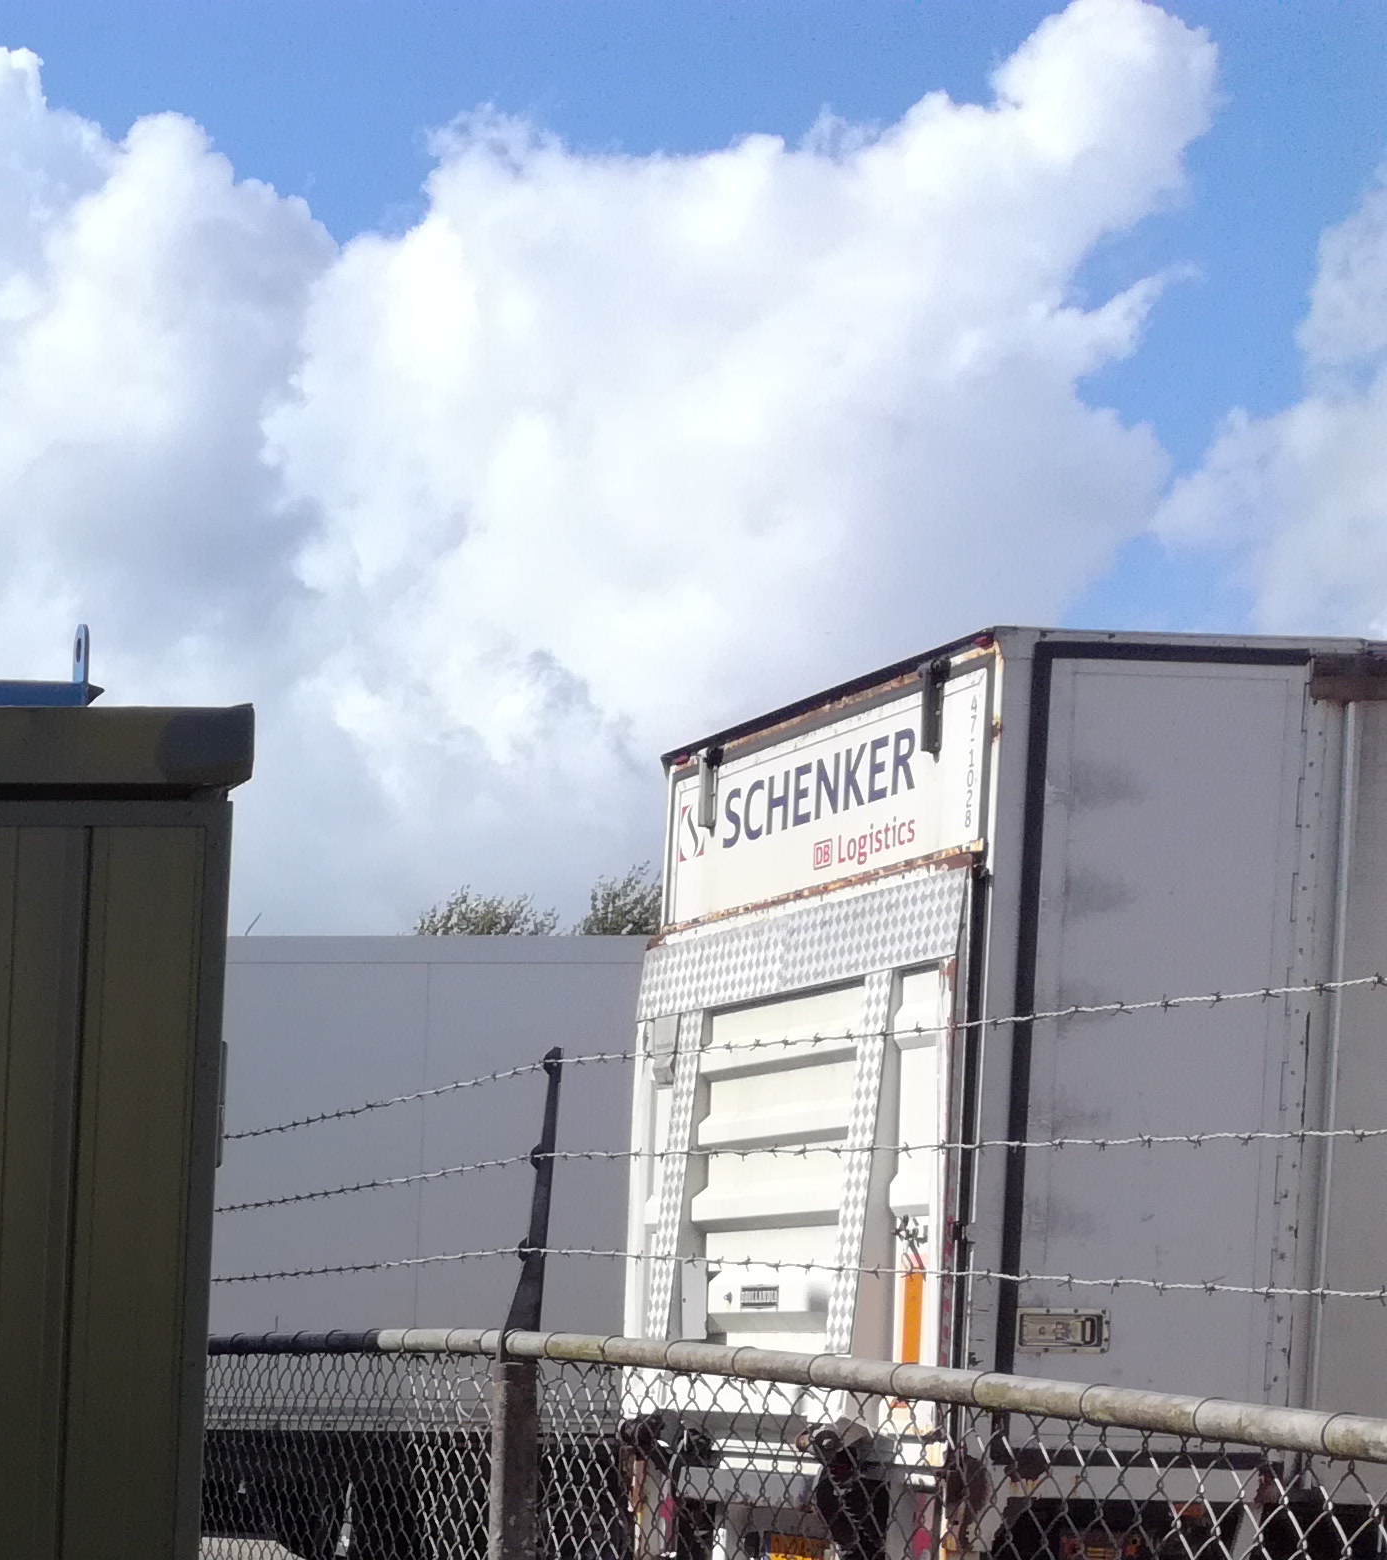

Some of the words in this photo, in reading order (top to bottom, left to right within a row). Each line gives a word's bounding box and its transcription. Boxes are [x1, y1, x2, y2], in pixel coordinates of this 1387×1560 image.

[722, 727, 916, 849] SCHENKER
[815, 843, 831, 866] DB
[837, 815, 916, 866] Logistics
